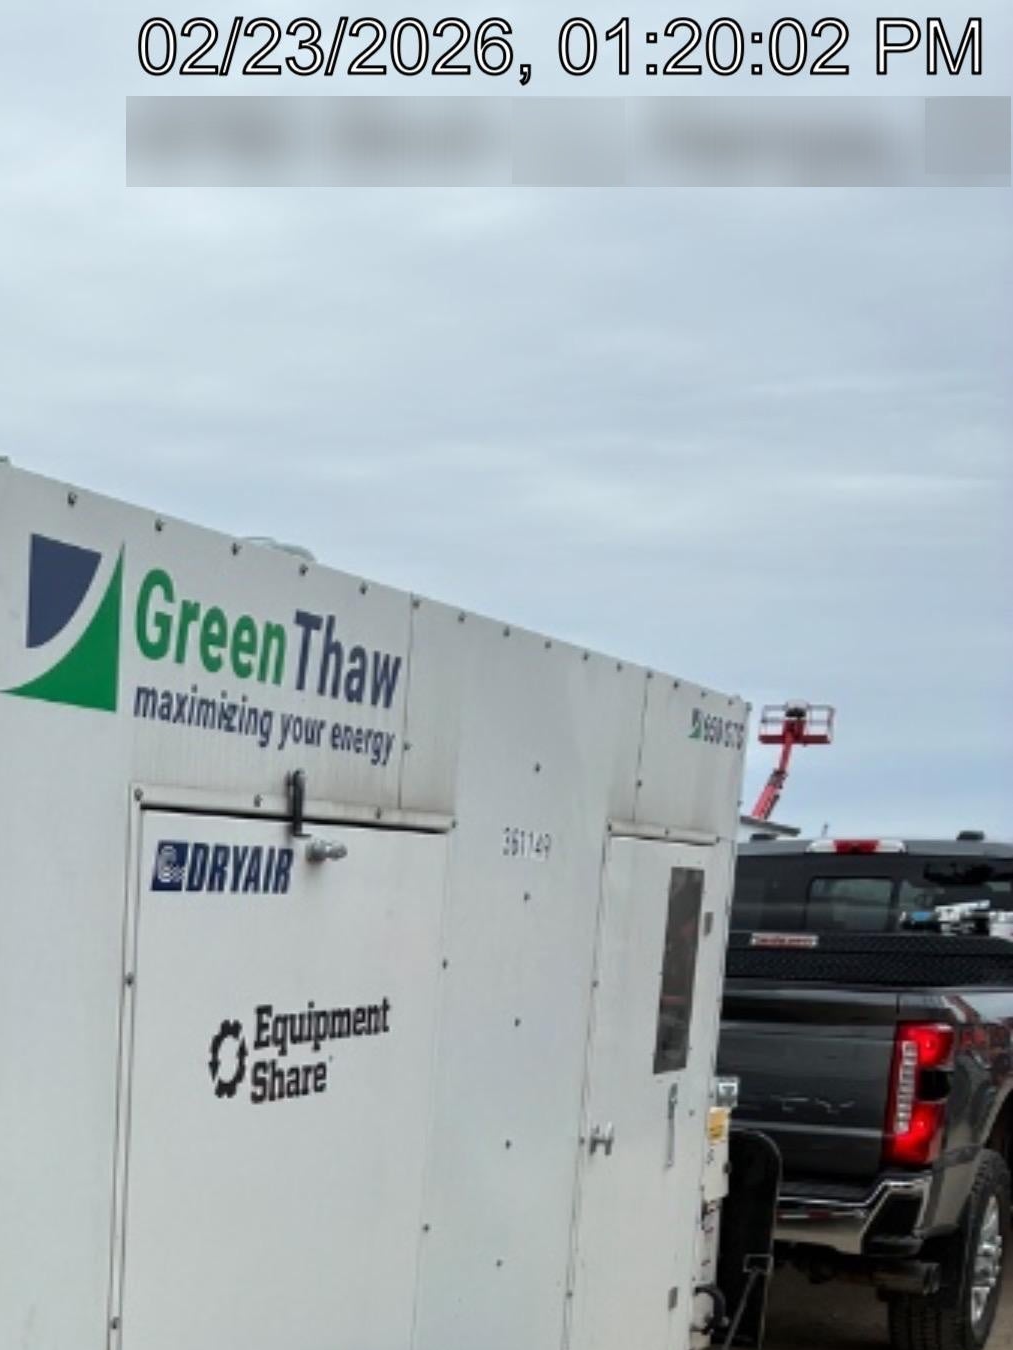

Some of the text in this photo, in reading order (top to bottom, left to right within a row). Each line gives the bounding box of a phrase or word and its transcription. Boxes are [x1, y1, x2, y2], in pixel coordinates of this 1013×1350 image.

[135, 568, 402, 709] GreenThaw
[133, 684, 396, 766] maximizing your energy
[185, 842, 294, 894] DRYAIR
[253, 996, 391, 1057] Equipment
[250, 1038, 328, 1104] Share
